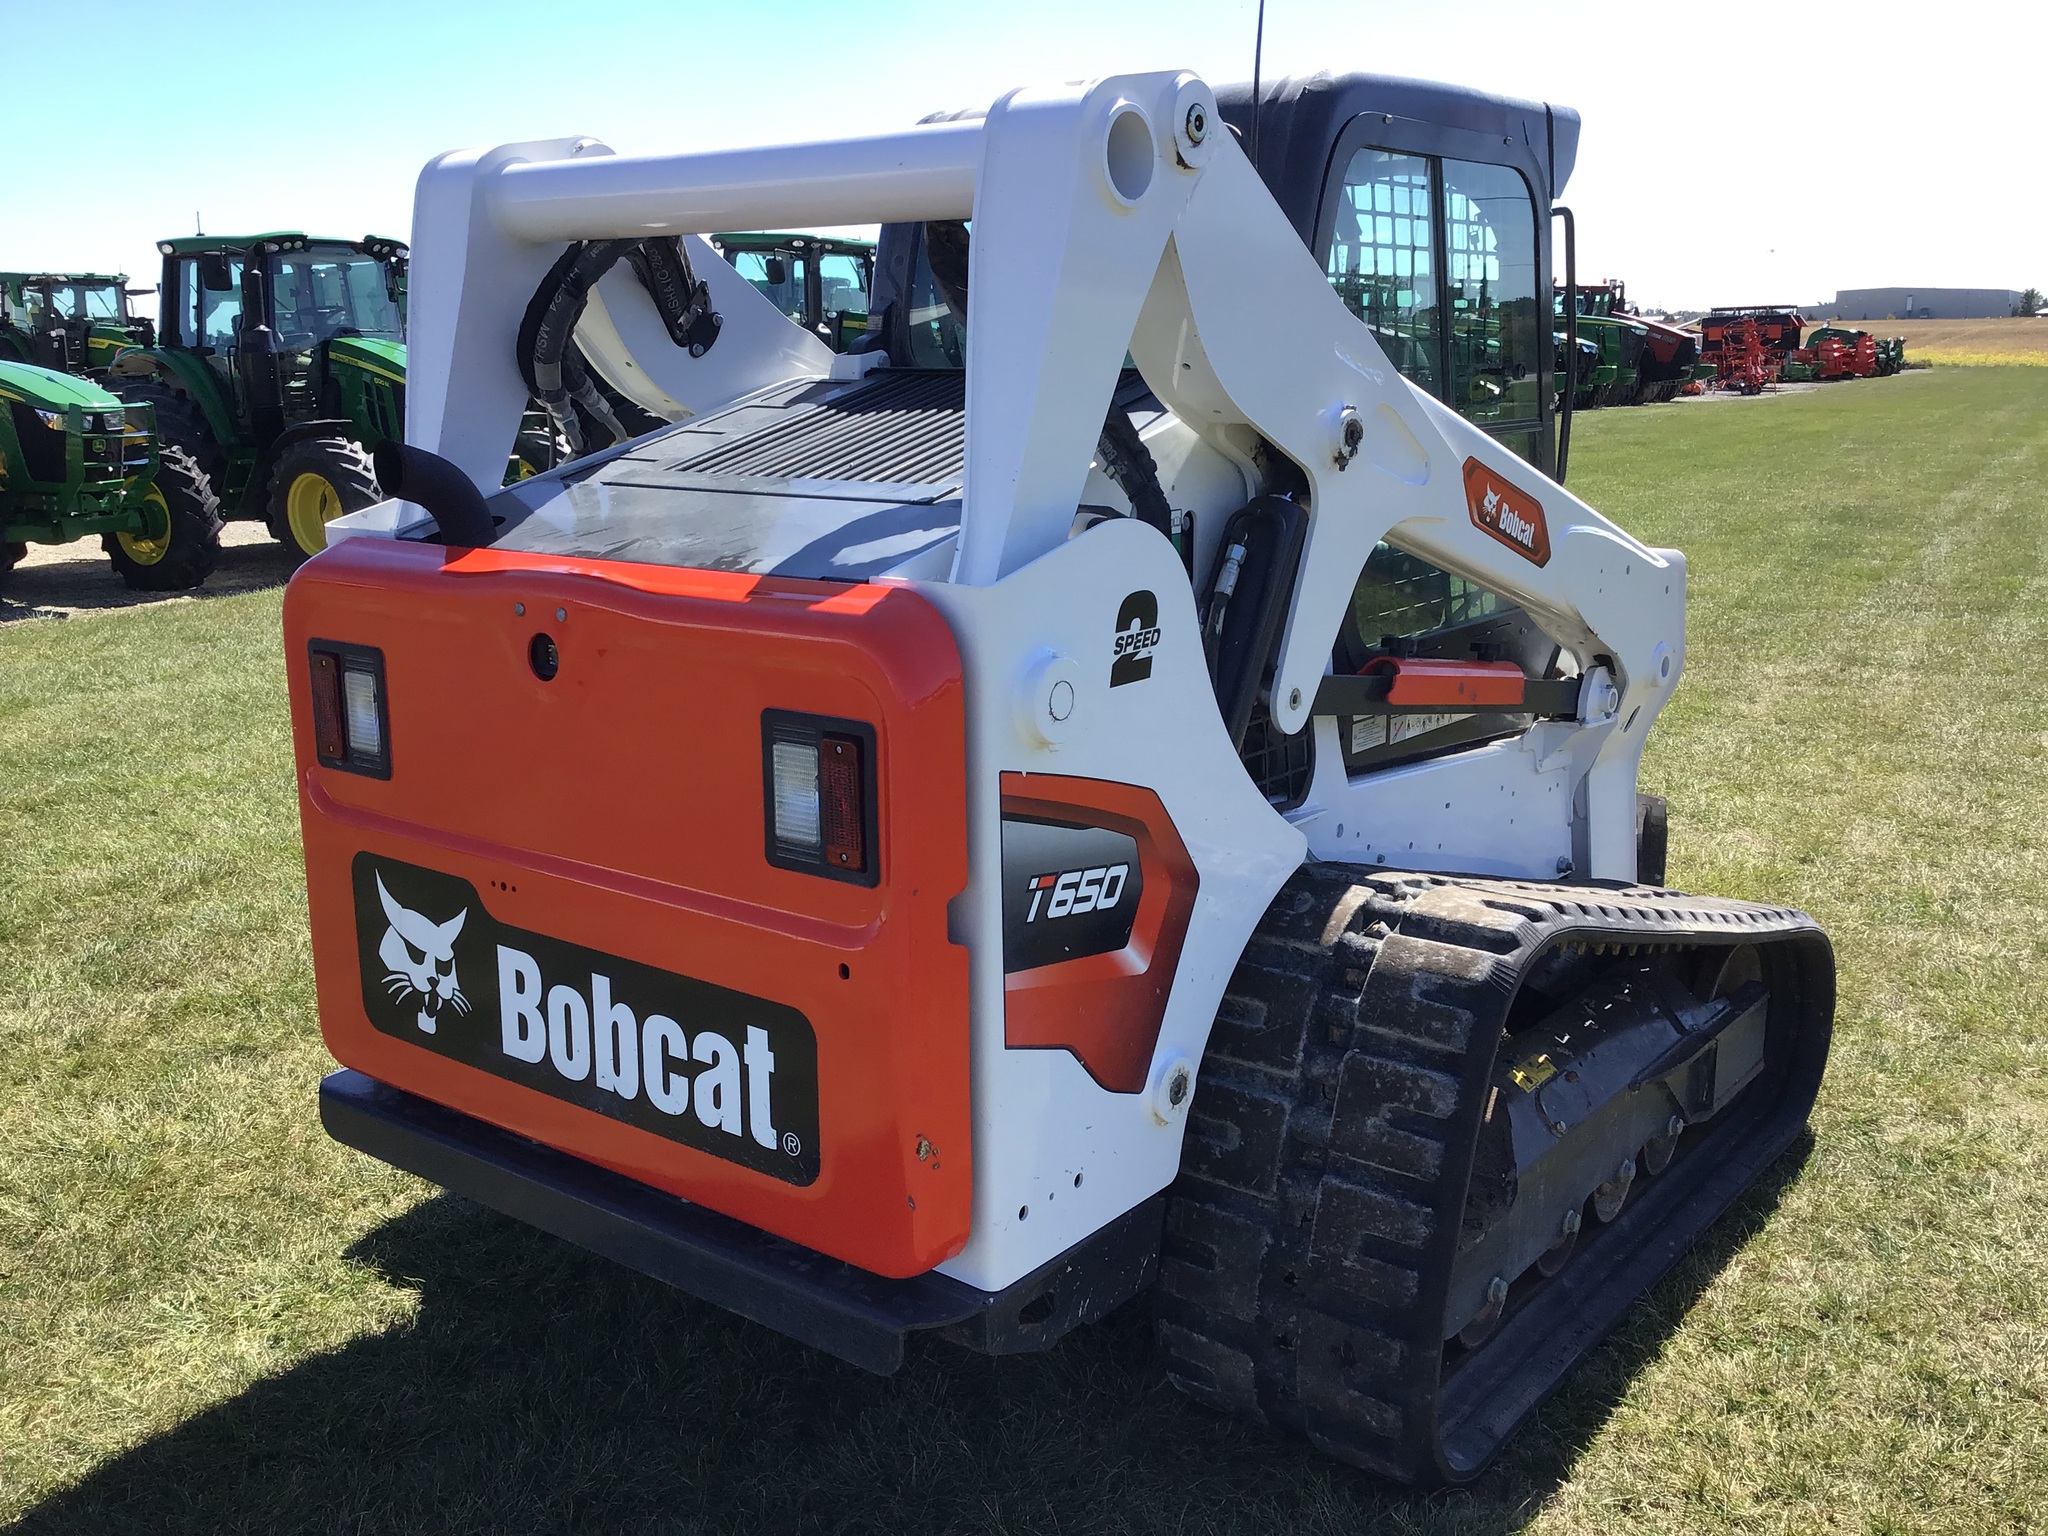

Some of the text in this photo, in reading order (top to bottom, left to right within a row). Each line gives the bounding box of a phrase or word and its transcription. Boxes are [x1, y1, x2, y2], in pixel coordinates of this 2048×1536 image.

[1499, 502, 1535, 550] Bobcat
[1109, 590, 1161, 688] 2 SPEED
[1026, 863, 1129, 923] T650
[497, 944, 778, 1151] Bobcat
